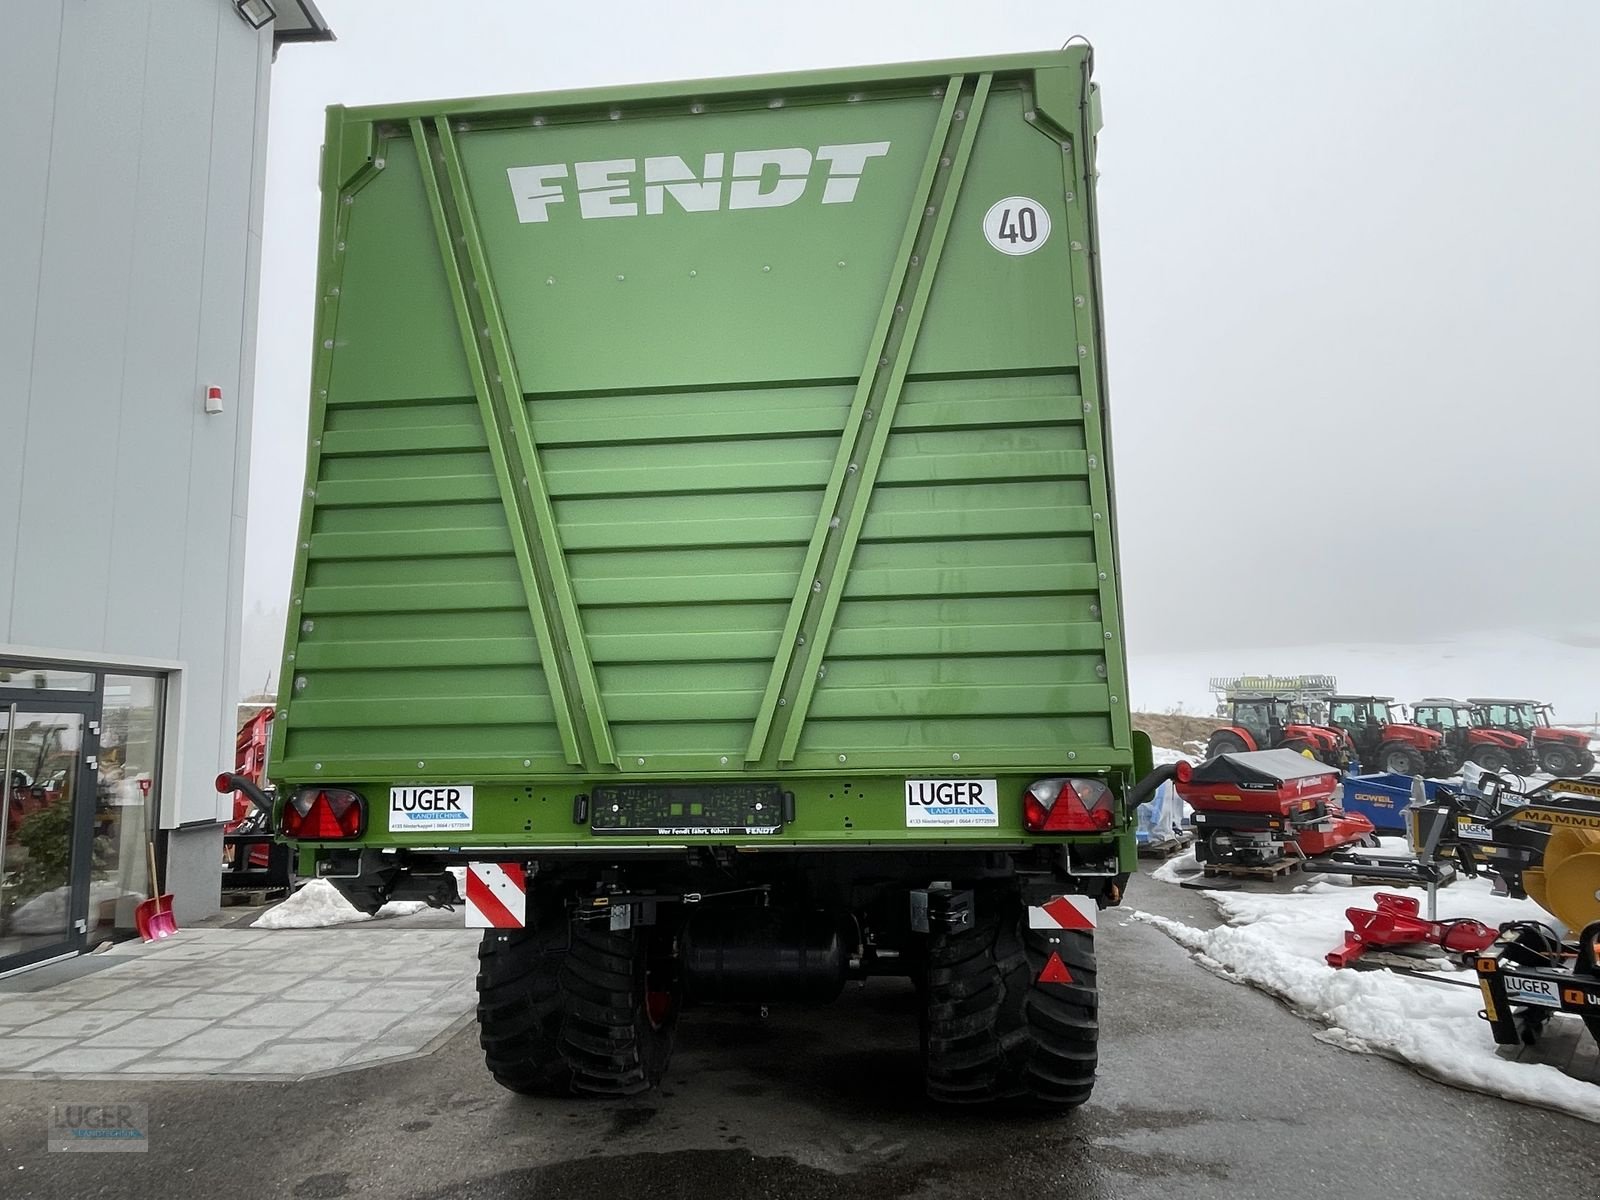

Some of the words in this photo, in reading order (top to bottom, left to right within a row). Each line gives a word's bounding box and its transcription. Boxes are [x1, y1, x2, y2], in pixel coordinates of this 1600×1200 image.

[506, 141, 891, 223] FENDT
[998, 207, 1037, 243] 40
[392, 789, 461, 811] LUGER
[908, 783, 985, 806] LUGER
[745, 827, 775, 835] FENDT
[1460, 824, 1487, 832] LUGER
[1506, 979, 1552, 995] LUGER
